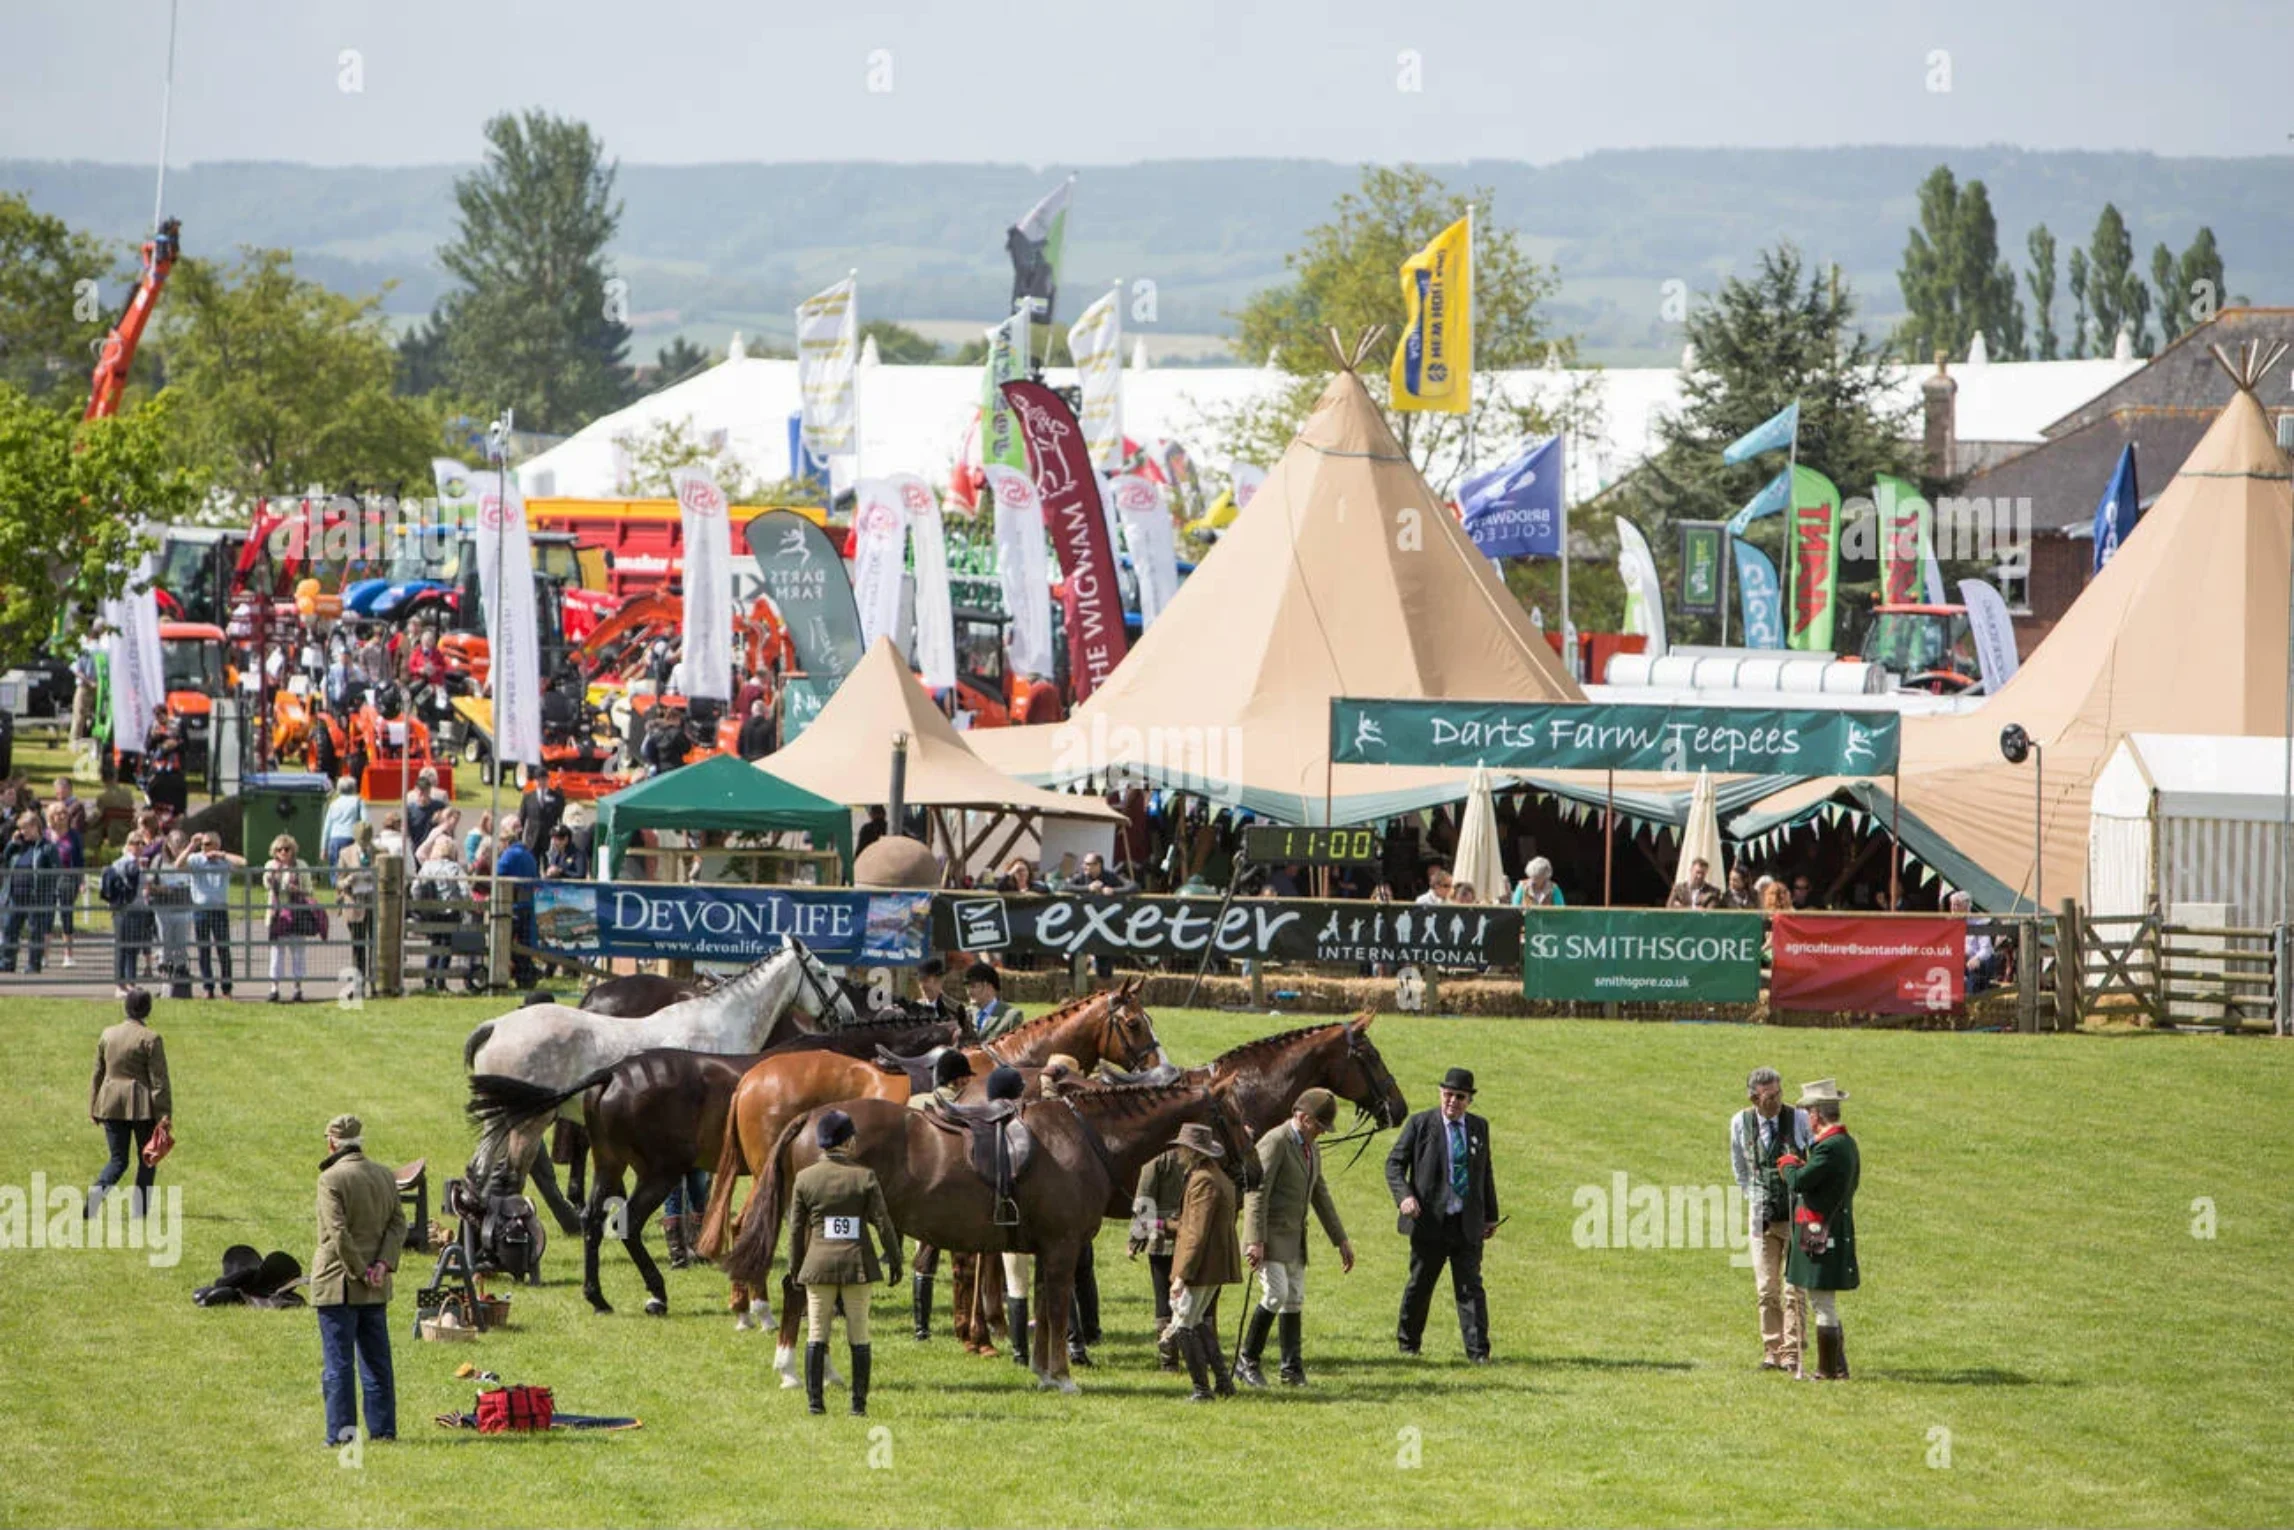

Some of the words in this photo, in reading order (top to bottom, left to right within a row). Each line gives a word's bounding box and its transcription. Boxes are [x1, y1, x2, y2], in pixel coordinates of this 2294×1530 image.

[1061, 501, 1106, 641] WIGWAM
[1431, 717, 1536, 749] Darts
[1549, 718, 1657, 750] Farm
[1666, 721, 1801, 766] Teepees
[1035, 902, 1300, 953] exeter
[1317, 945, 1490, 966] INTERNATIONAL
[1565, 934, 1755, 962] SMITHSGORE
[1785, 942, 1953, 957] agriculture@santander.co.uk
[1594, 975, 1690, 990] smithsgore.co.uk
[833, 1218, 850, 1235] 69
